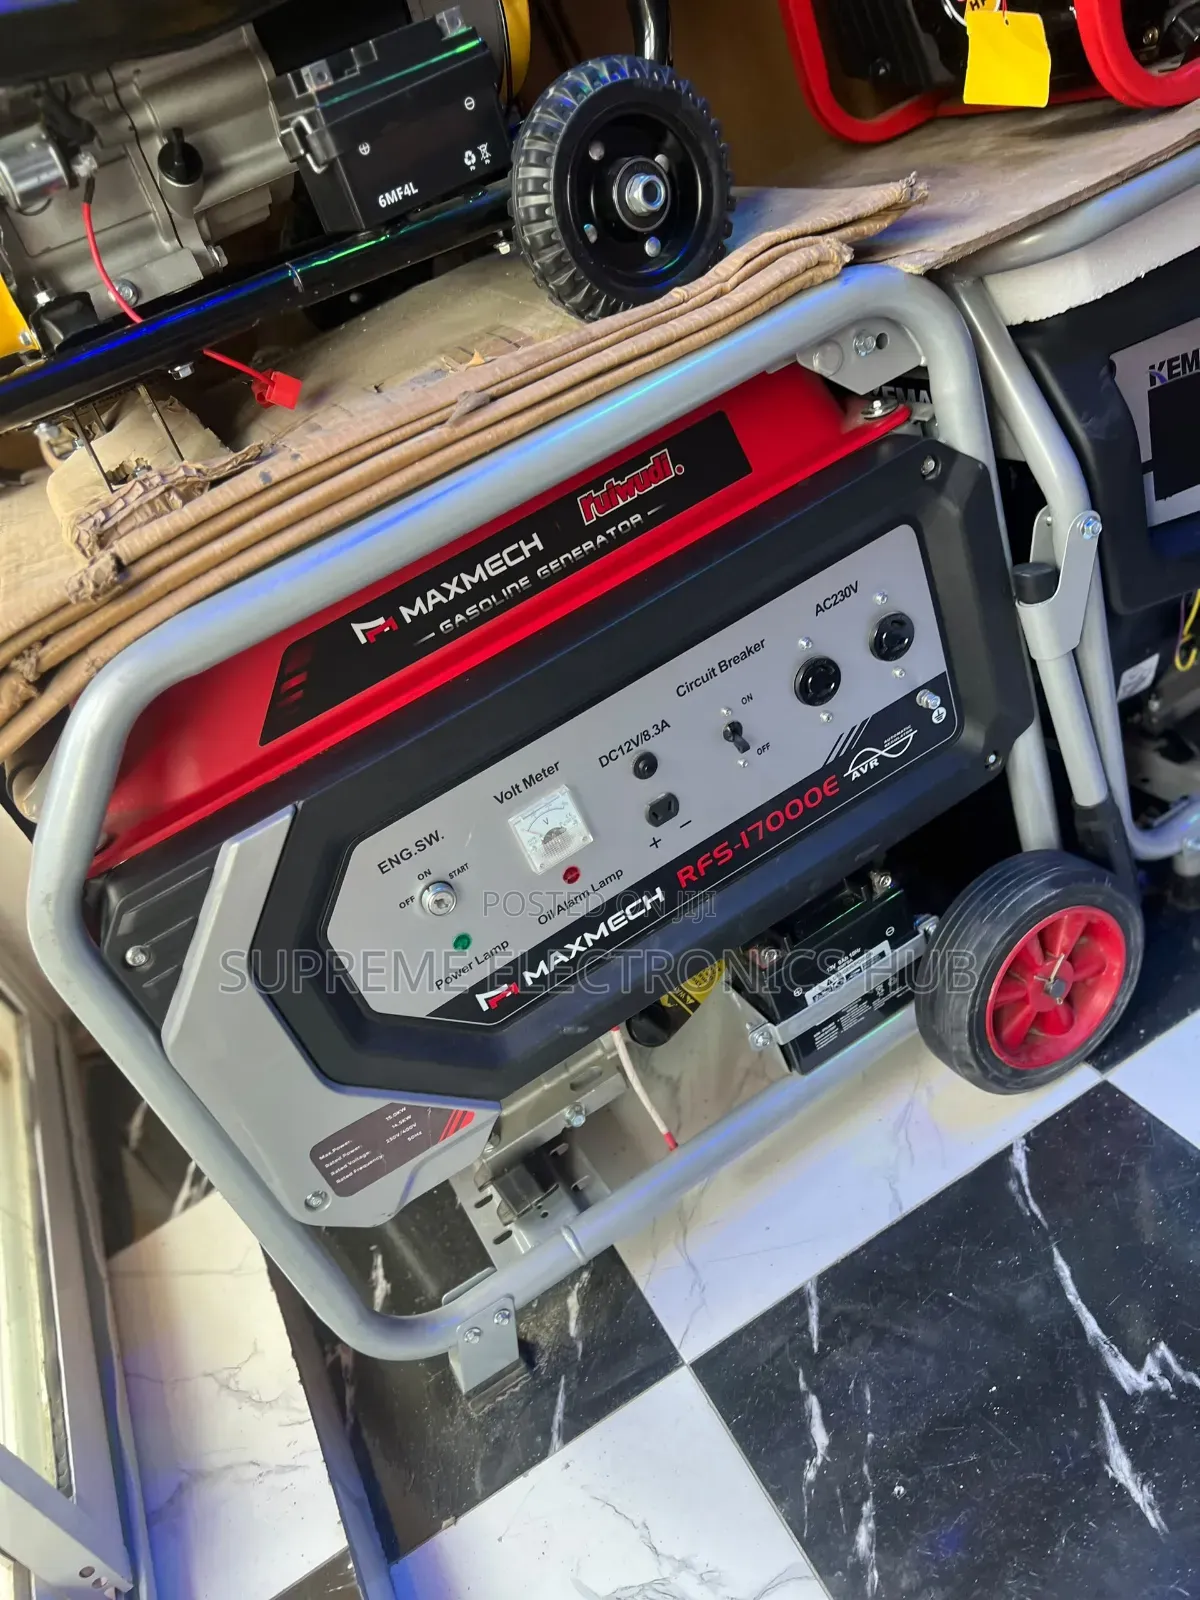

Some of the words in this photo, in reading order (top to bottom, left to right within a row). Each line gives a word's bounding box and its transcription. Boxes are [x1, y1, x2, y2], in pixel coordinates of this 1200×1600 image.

[378, 182, 419, 208] 6MF4L
[399, 533, 544, 624] MAXMECH
[439, 576, 533, 634] GASOLINE
[536, 513, 644, 580] GENERATOR
[814, 580, 860, 617] AC230V
[676, 668, 718, 698] Circuit
[718, 638, 767, 673] Breaker
[741, 693, 754, 705] ON
[598, 719, 671, 768] DC12V/8.3A
[756, 742, 772, 756] OFF
[493, 784, 522, 805] Volt
[522, 761, 561, 789] Meter
[852, 758, 880, 781] AVR
[377, 830, 445, 875] ENG.SW.
[417, 868, 432, 881] ON
[448, 863, 470, 880] START
[522, 887, 665, 986] MAXMECH
[677, 774, 840, 888] RFS-17000E
[537, 907, 555, 926] Oil
[556, 890, 590, 914] Alarm
[590, 868, 624, 893] Lamp
[398, 896, 416, 909] OFF
[435, 963, 474, 990] Power
[475, 939, 510, 965] Lamp
